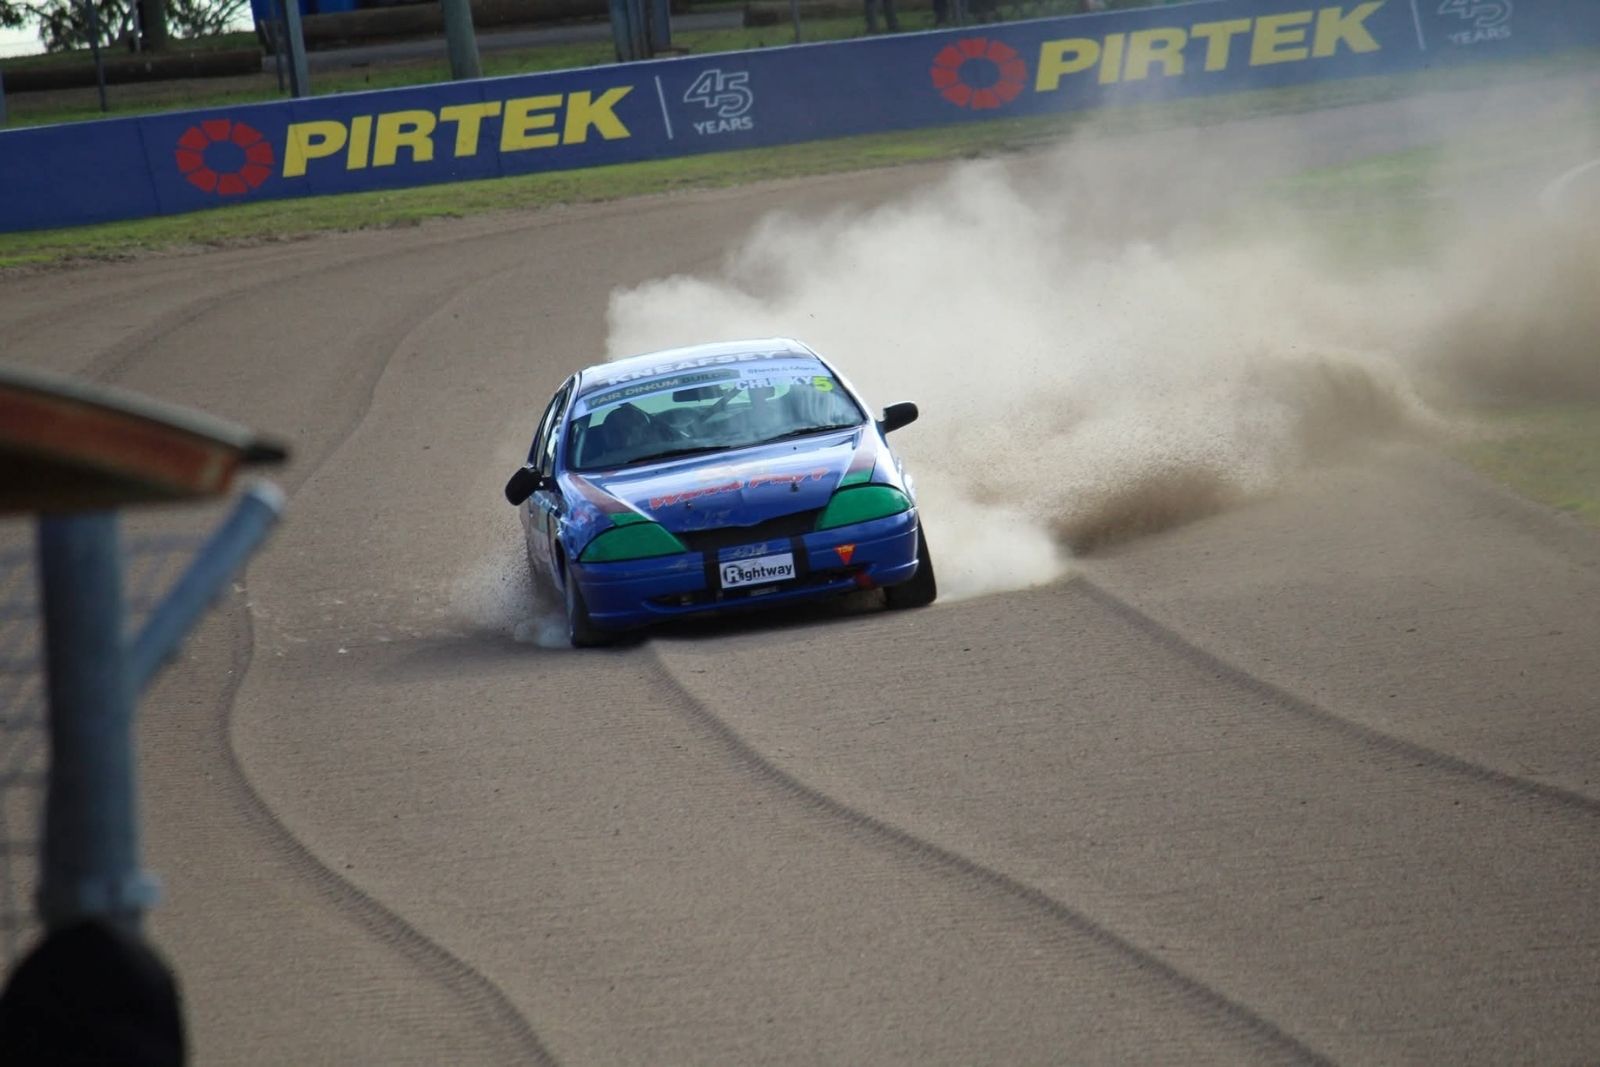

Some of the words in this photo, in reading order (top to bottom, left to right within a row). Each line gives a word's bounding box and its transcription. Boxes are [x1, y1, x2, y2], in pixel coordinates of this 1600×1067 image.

[1437, 0, 1512, 28] 45
[1035, 1, 1383, 92] PIRTEK
[1449, 25, 1511, 45] YEARS
[683, 69, 754, 118] 45
[283, 86, 634, 178] PIRTEK
[694, 115, 754, 135] YEARS
[590, 392, 621, 406] FAIR
[624, 379, 679, 396] DINKUM
[736, 376, 812, 390] CHUKY
[812, 376, 834, 393] 5
[724, 563, 793, 584] Rightway
